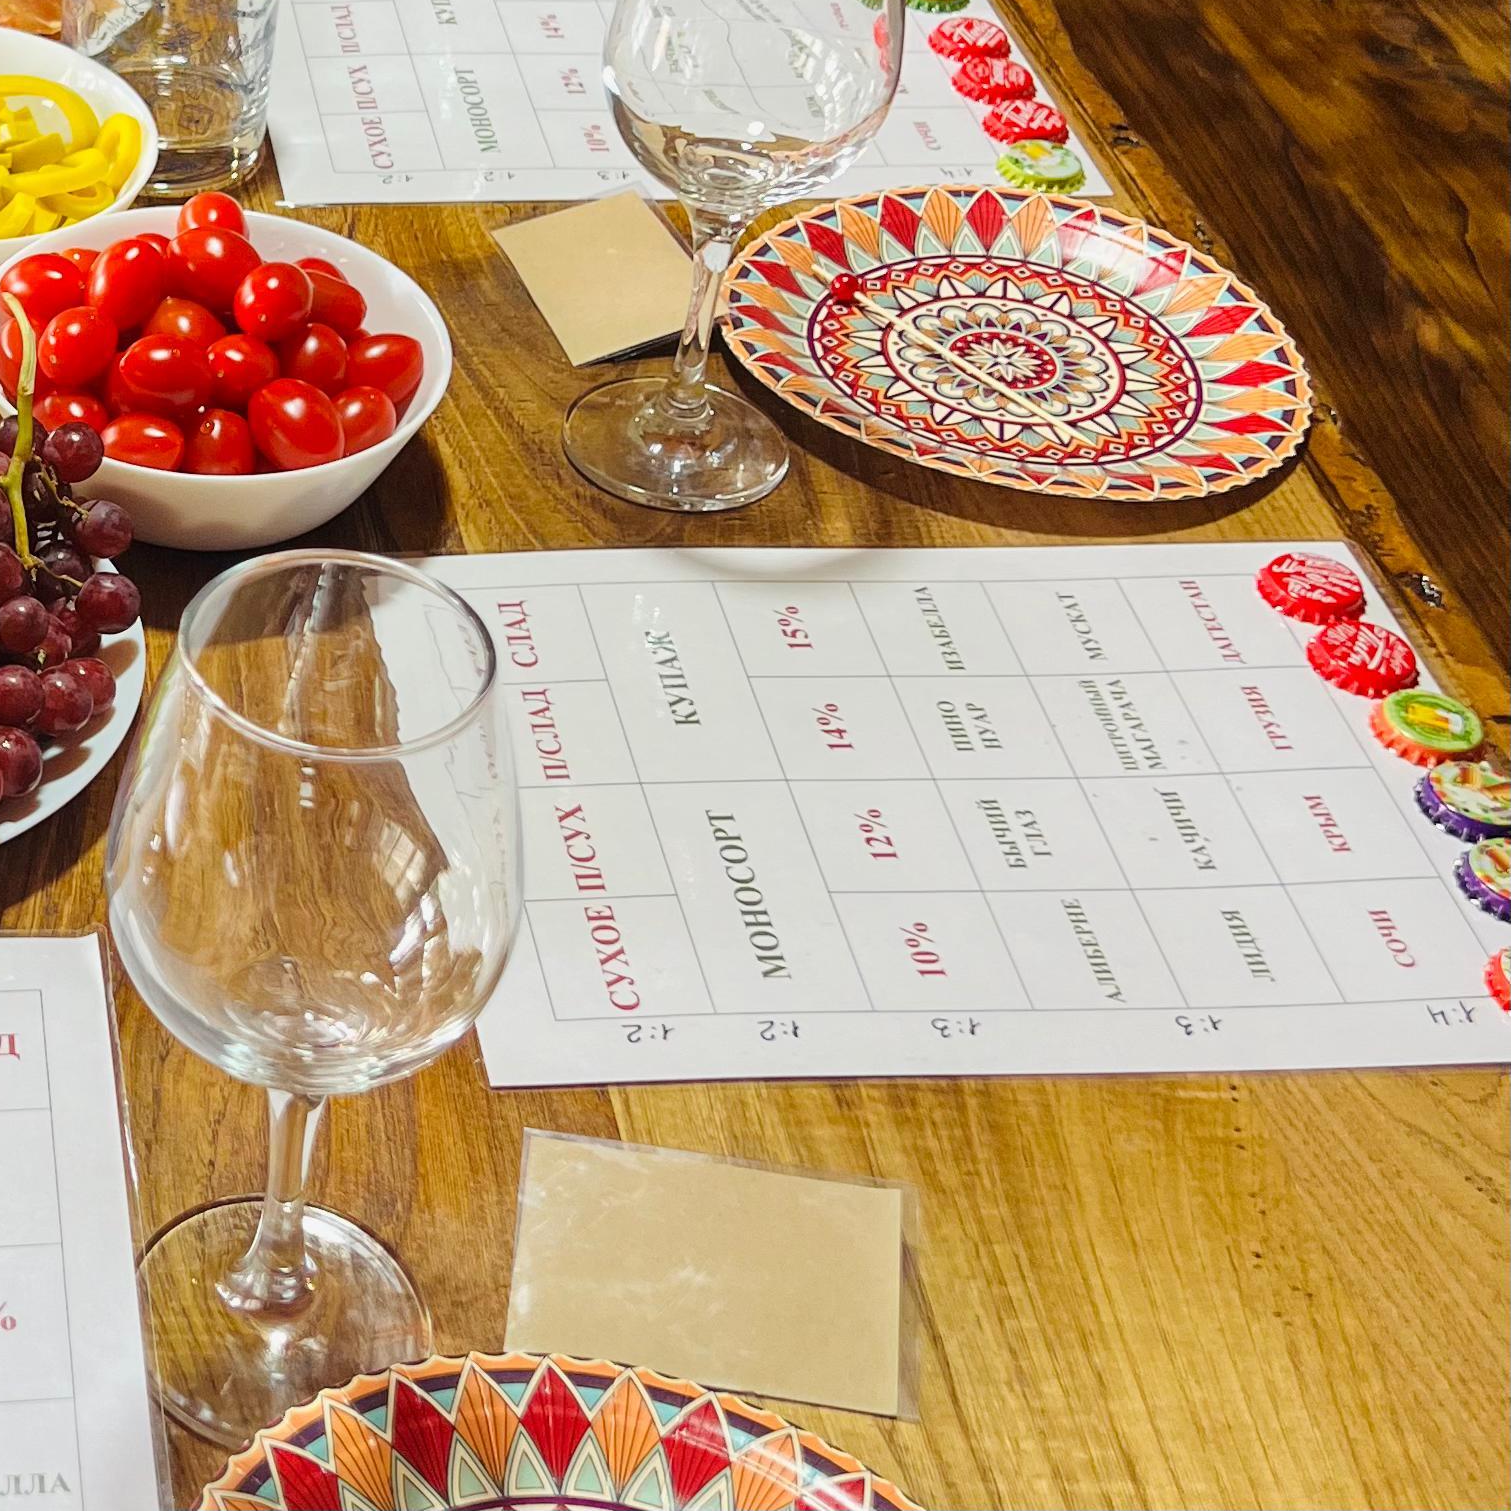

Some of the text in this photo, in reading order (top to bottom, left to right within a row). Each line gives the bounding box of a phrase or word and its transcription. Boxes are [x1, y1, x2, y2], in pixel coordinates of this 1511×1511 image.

[331, 4, 362, 54] П/СЛАД
[537, 13, 566, 40] 14%
[347, 65, 378, 112] П/СУХ
[454, 68, 502, 154] МОНОСОРТ
[558, 68, 587, 95] 12%
[361, 116, 395, 170] СУХОЕ
[582, 124, 610, 154] 10%
[913, 586, 967, 672] ИЗАБЕЛЛА
[1055, 591, 1109, 662] МУСКАТ
[936, 699, 975, 753] ПИНО
[966, 702, 1004, 751] НУАР
[1106, 679, 1169, 771] МАГАРАЧА
[497, 600, 641, 1011] СУХОЕ П/СУХ П/СЛАД СЛАД
[645, 629, 792, 980] МОНОСОРТ КУПАЖ
[772, 605, 948, 979] 10% 12% 14% 15%
[1179, 580, 1418, 968] СОЧИ КРЫМ ГРУЗИЯ ДАГЕСТАН
[974, 798, 1028, 870] БЫЧИЙ
[1014, 809, 1053, 857] ГЛАЗ
[1060, 898, 1128, 1004] АЛИБЕРНЕ
[1221, 909, 1277, 983] ЛИДИЯ
[621, 1023, 675, 1044] 1:2
[758, 1019, 801, 1041] 1:2
[931, 1017, 982, 1038] 1:3
[1175, 1015, 1224, 1037] 1:3
